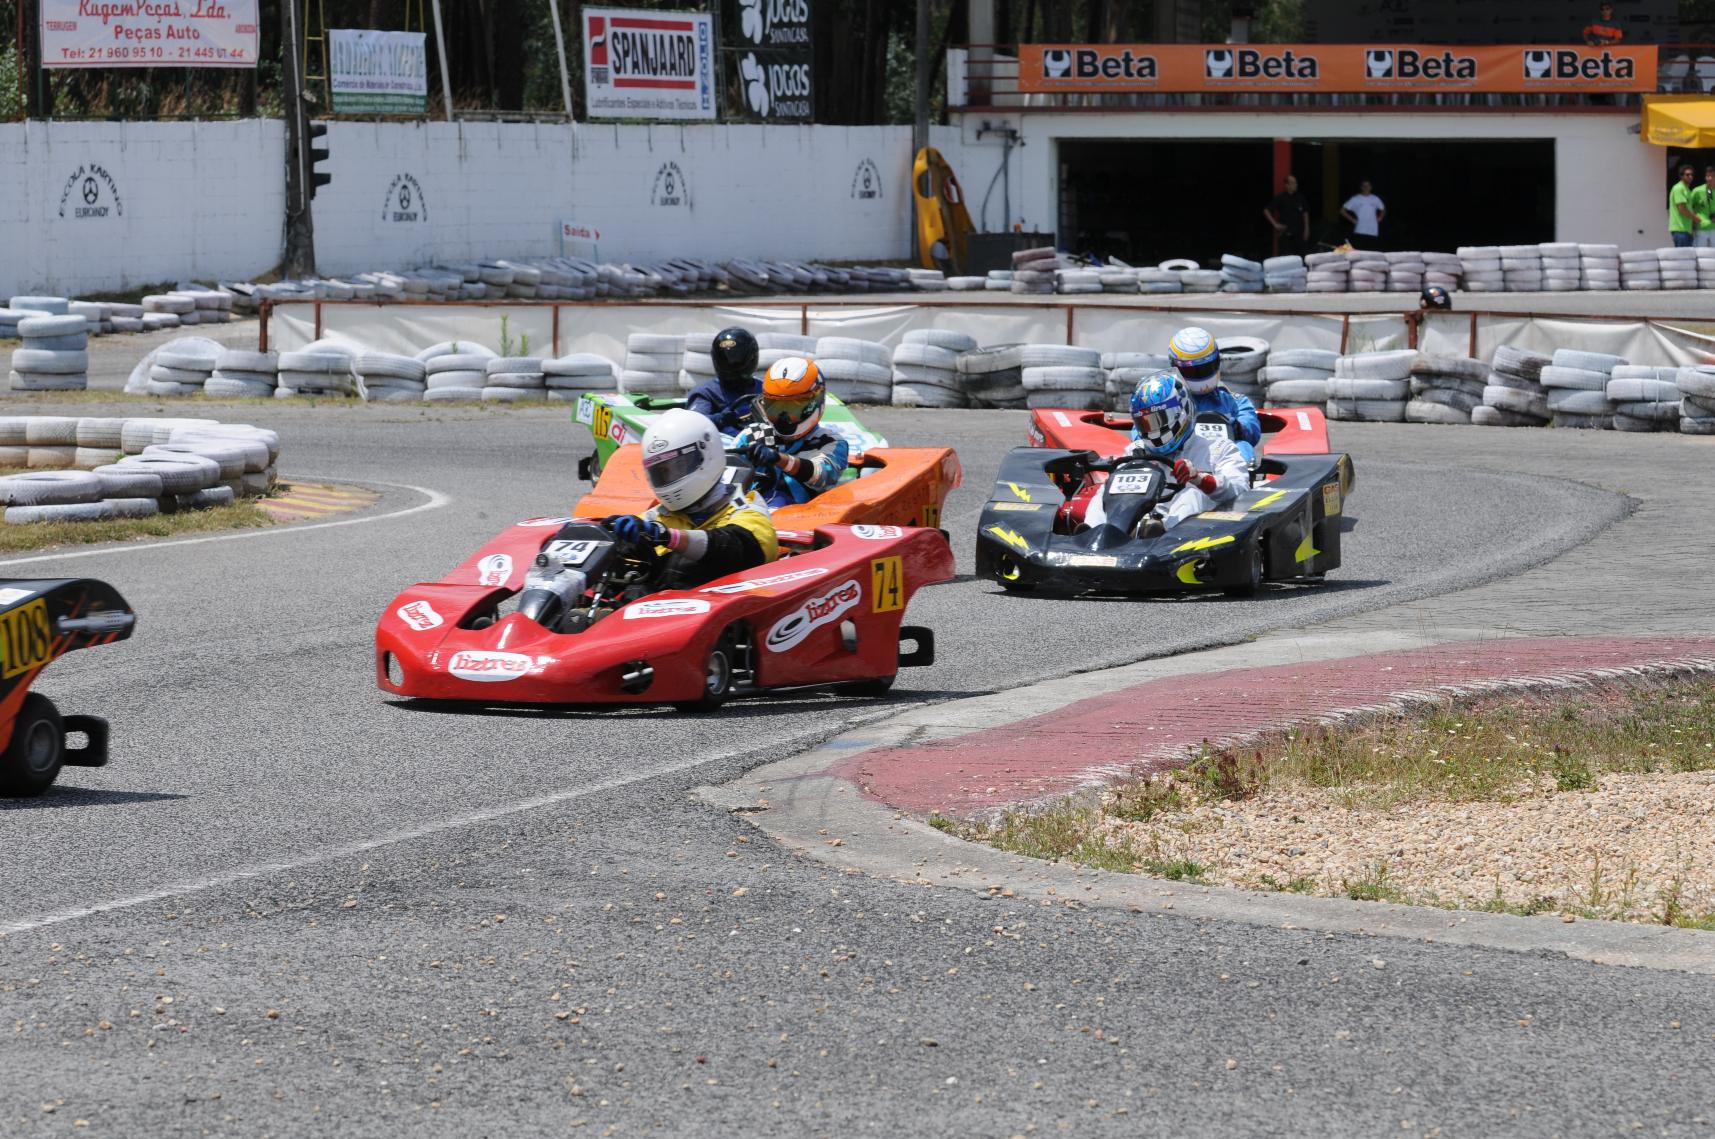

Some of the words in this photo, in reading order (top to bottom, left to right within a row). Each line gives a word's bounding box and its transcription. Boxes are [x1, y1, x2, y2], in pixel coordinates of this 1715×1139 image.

[765, 0, 809, 35] JOGOS
[114, 25, 161, 43] Peças
[167, 25, 200, 39] Auto
[61, 48, 85, 58] Tel:
[89, 48, 102, 58] 21
[107, 48, 129, 58] 960
[133, 48, 146, 58] 95
[150, 47, 163, 57] 10
[178, 47, 191, 57] 21
[195, 48, 214, 58] 445
[612, 32, 696, 77] SPANJAARD
[1076, 49, 1157, 78] Beta
[1237, 49, 1318, 78] Beta
[1397, 49, 1477, 78] Beta
[1556, 49, 1635, 78] Beta
[768, 63, 810, 108] JOGOS
[1199, 424, 1223, 432] 39
[1118, 475, 1148, 483] 103
[554, 541, 589, 552] 74
[875, 560, 899, 609] 74
[2, 604, 49, 670] 108
